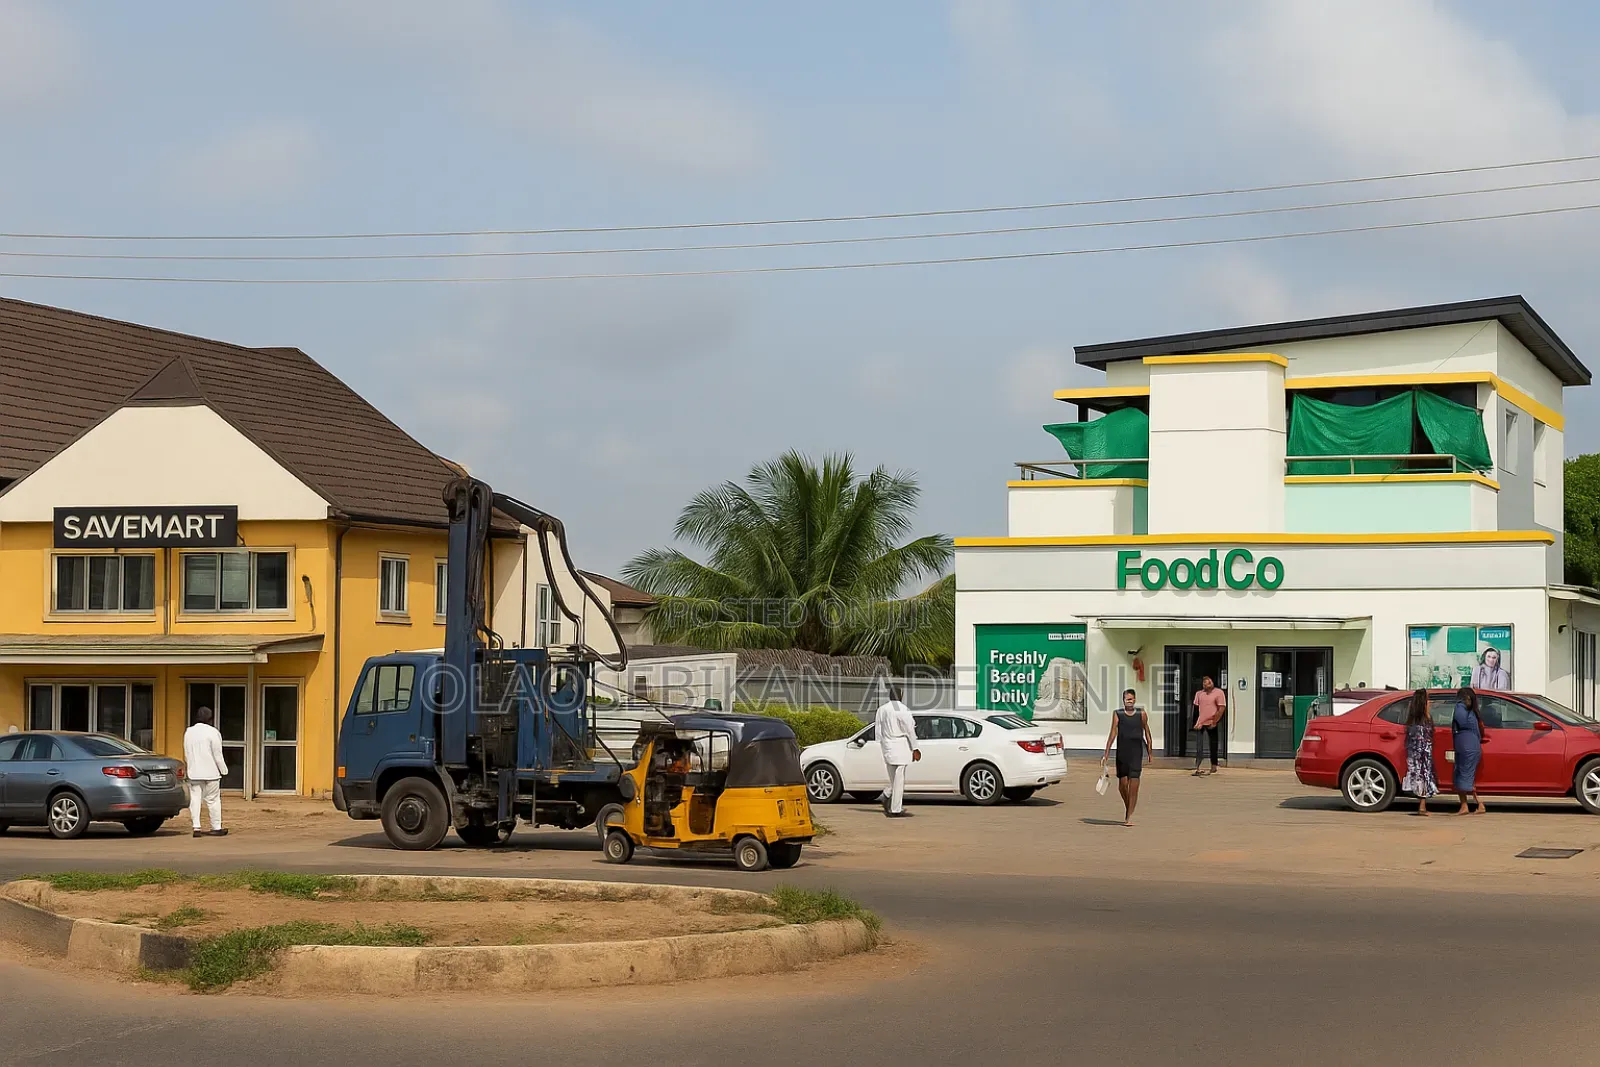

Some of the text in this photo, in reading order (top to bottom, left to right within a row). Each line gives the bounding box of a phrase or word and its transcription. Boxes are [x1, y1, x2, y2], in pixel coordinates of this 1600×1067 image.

[63, 514, 225, 539] SAVEMART
[990, 649, 1047, 668] Freshly
[990, 668, 1036, 684] Bated
